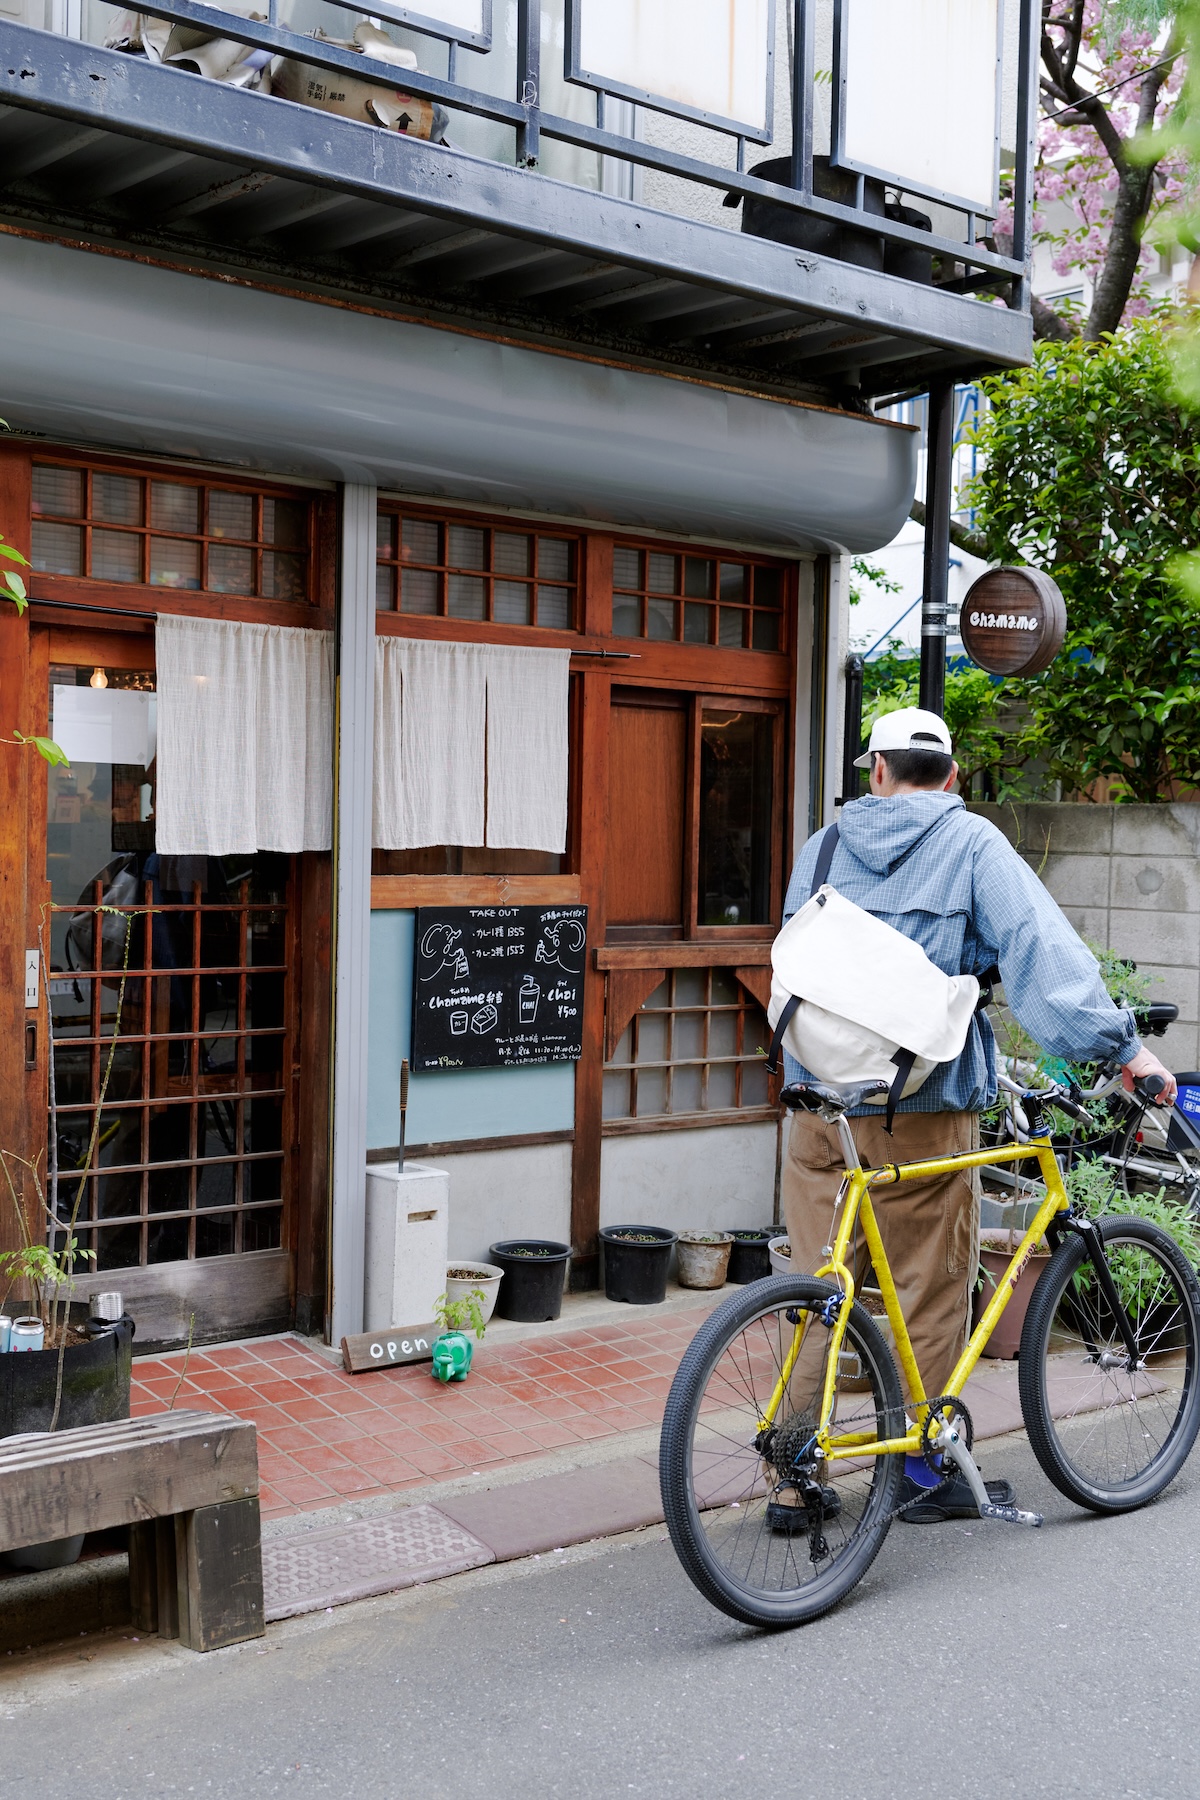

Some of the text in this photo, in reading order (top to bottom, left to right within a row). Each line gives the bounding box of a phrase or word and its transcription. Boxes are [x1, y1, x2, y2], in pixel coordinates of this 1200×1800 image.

[469, 908, 520, 918] TAKE OUT
[27, 960, 37, 997] 入口
[521, 1001, 535, 1010] CHAI
[557, 1004, 577, 1018] ¥500
[369, 1338, 429, 1360] open
